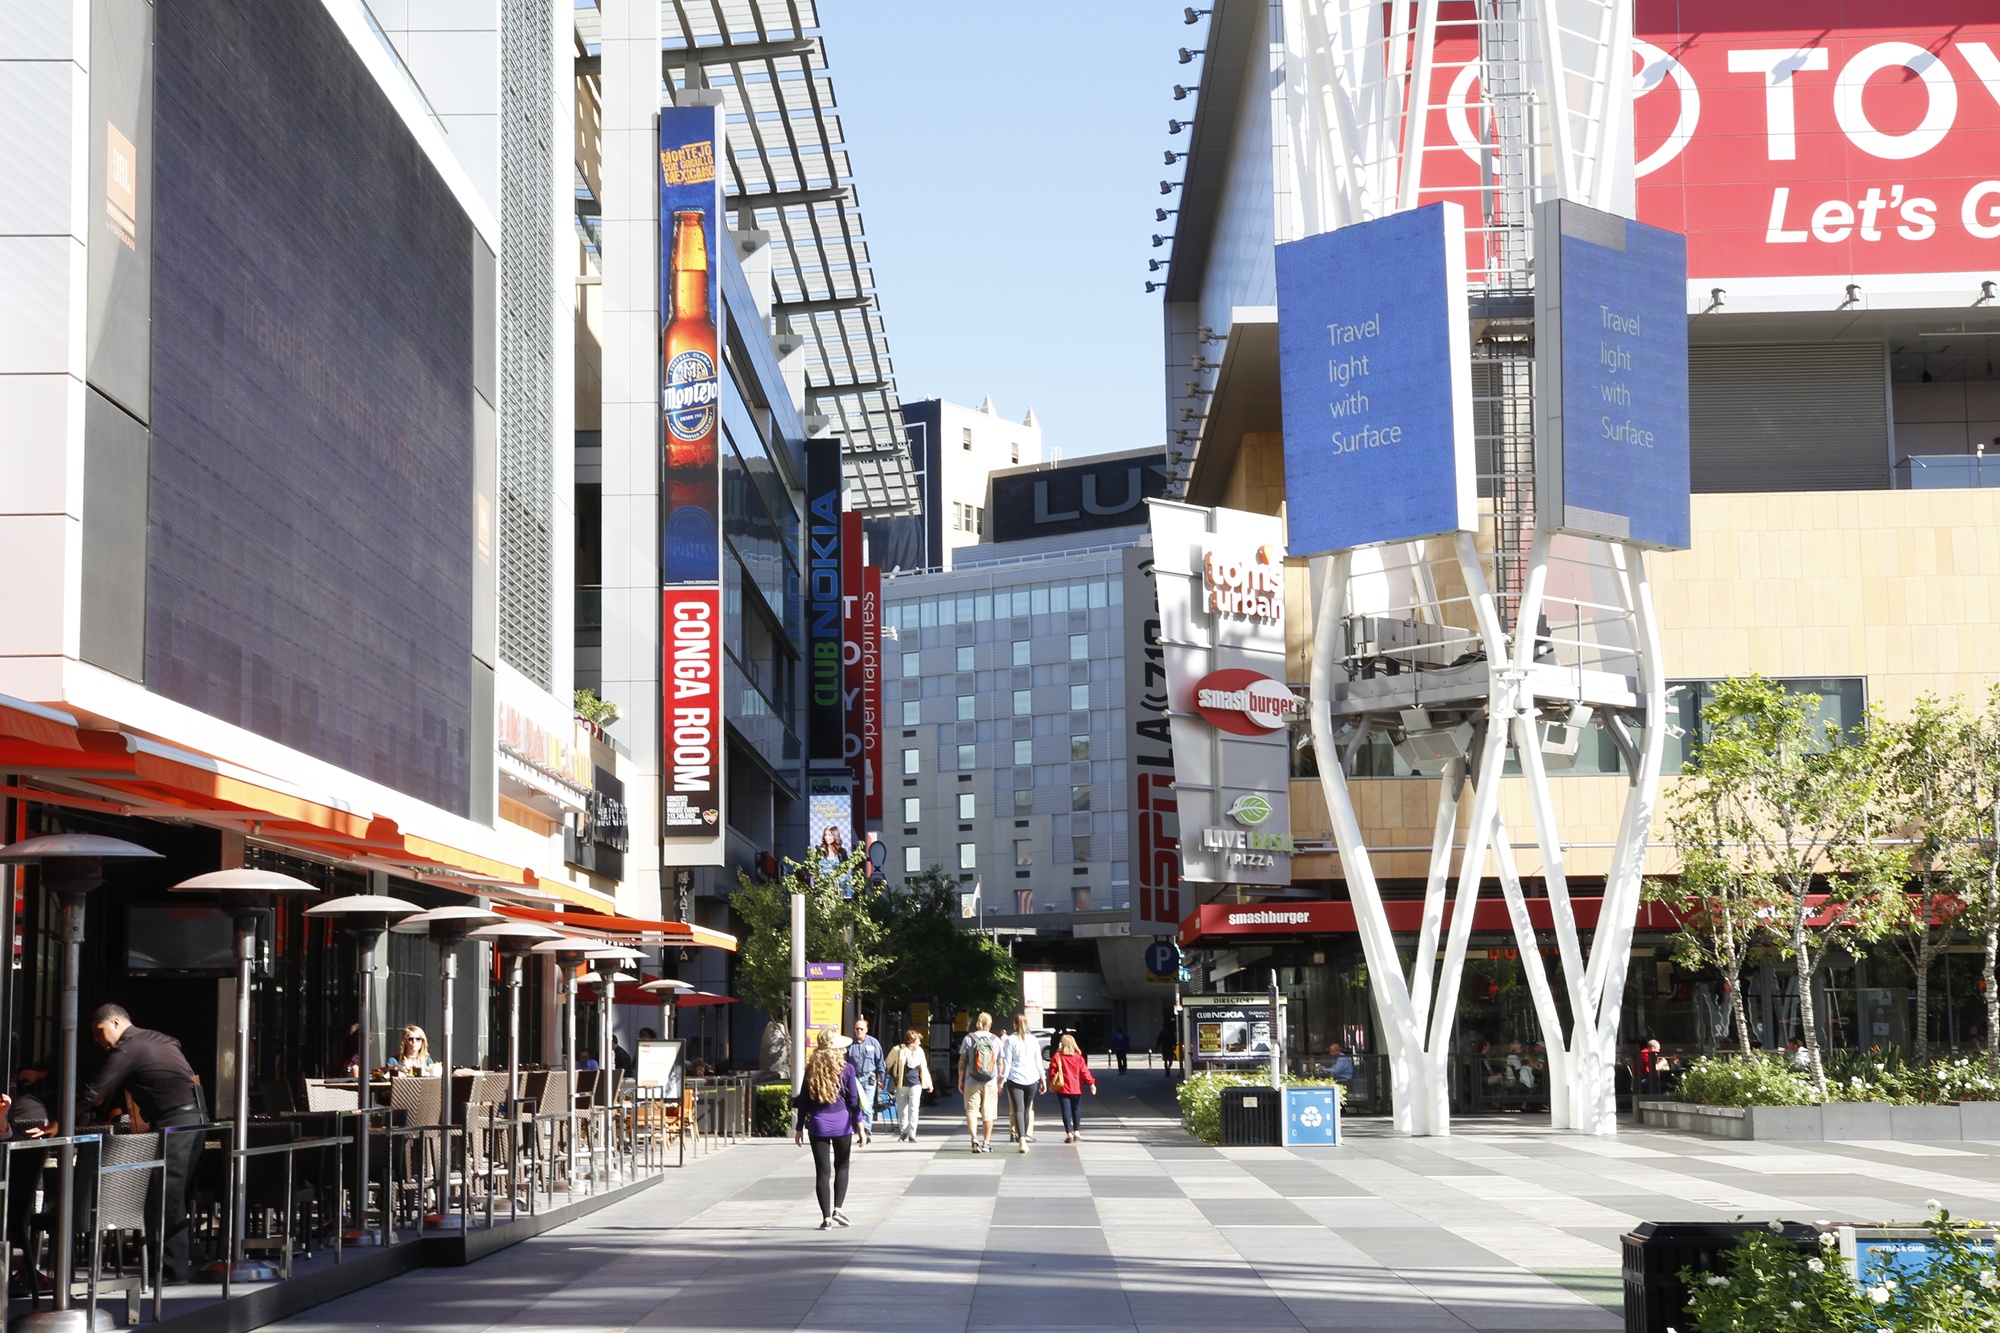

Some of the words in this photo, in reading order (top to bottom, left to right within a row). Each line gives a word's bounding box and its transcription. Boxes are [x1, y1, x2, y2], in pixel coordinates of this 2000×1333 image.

[661, 145, 712, 163] MONTEJO
[664, 165, 716, 184] MEXICANO
[1765, 185, 1937, 243] Let's
[1327, 313, 1381, 346] Travel
[1600, 305, 1641, 337] Travel
[1328, 356, 1370, 387] light
[1600, 342, 1632, 373] light
[664, 381, 718, 410] Montejo
[1330, 391, 1370, 418] with
[1600, 382, 1631, 408] with
[1332, 424, 1402, 455] Surface
[1601, 416, 1654, 448] Surface
[1034, 464, 1166, 523] LU
[811, 489, 839, 637] NOKIA
[1211, 592, 1285, 623] urban
[673, 601, 711, 699] CONGA
[814, 641, 839, 706] CLUB
[1198, 688, 1294, 716] smashburger
[843, 595, 862, 847] TOYO
[864, 700, 878, 749] open
[673, 707, 711, 792] ROOM
[1203, 828, 1246, 852] LIVE
[1251, 831, 1298, 853] BASIL
[1230, 853, 1274, 867] PIZZA
[679, 885, 688, 961] KATSA
[1229, 911, 1309, 925] smashburger
[1156, 946, 1171, 971] P
[1196, 1011, 1211, 1019] CLUB
[1211, 1010, 1245, 1018] NOKIA
